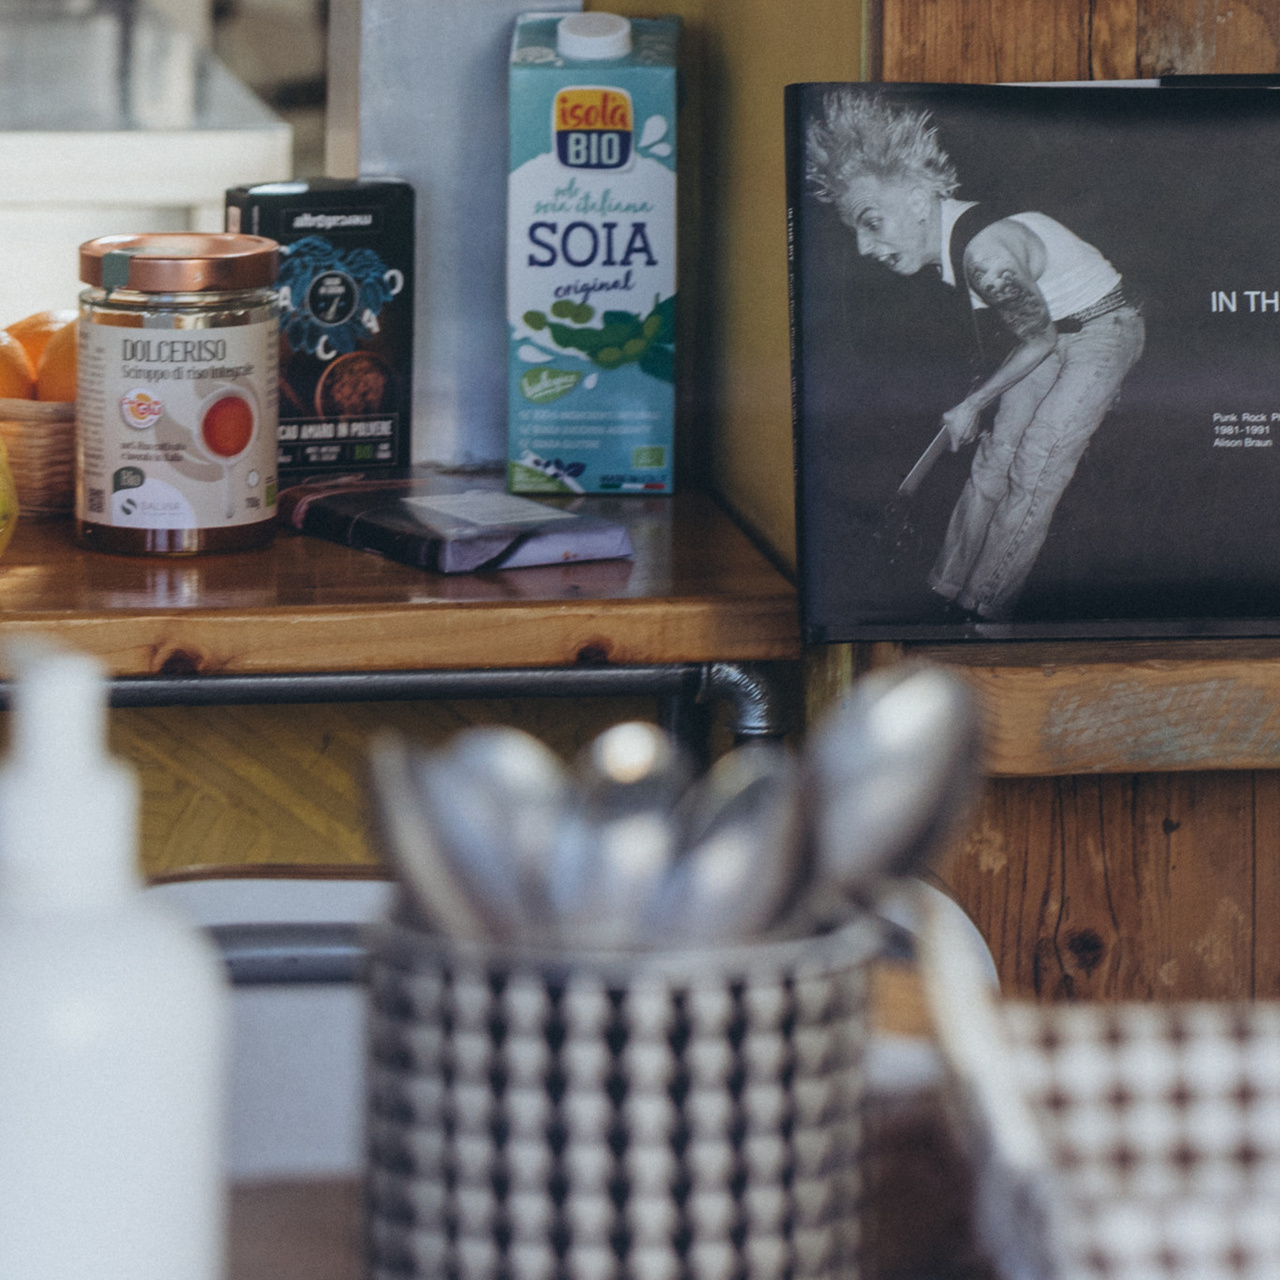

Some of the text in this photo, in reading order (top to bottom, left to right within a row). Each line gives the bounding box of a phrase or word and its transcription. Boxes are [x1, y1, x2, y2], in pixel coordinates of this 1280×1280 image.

[559, 92, 629, 128] isola
[567, 133, 621, 166] BIO
[527, 220, 658, 268] SOIA
[553, 269, 635, 306] original
[1211, 291, 1237, 313] IN
[121, 339, 227, 363] DOLCERISO
[1213, 413, 1239, 423] Punk
[1242, 413, 1268, 423] Rock
[1214, 426, 1271, 435] 1981-1991
[1213, 438, 1242, 448] Alison
